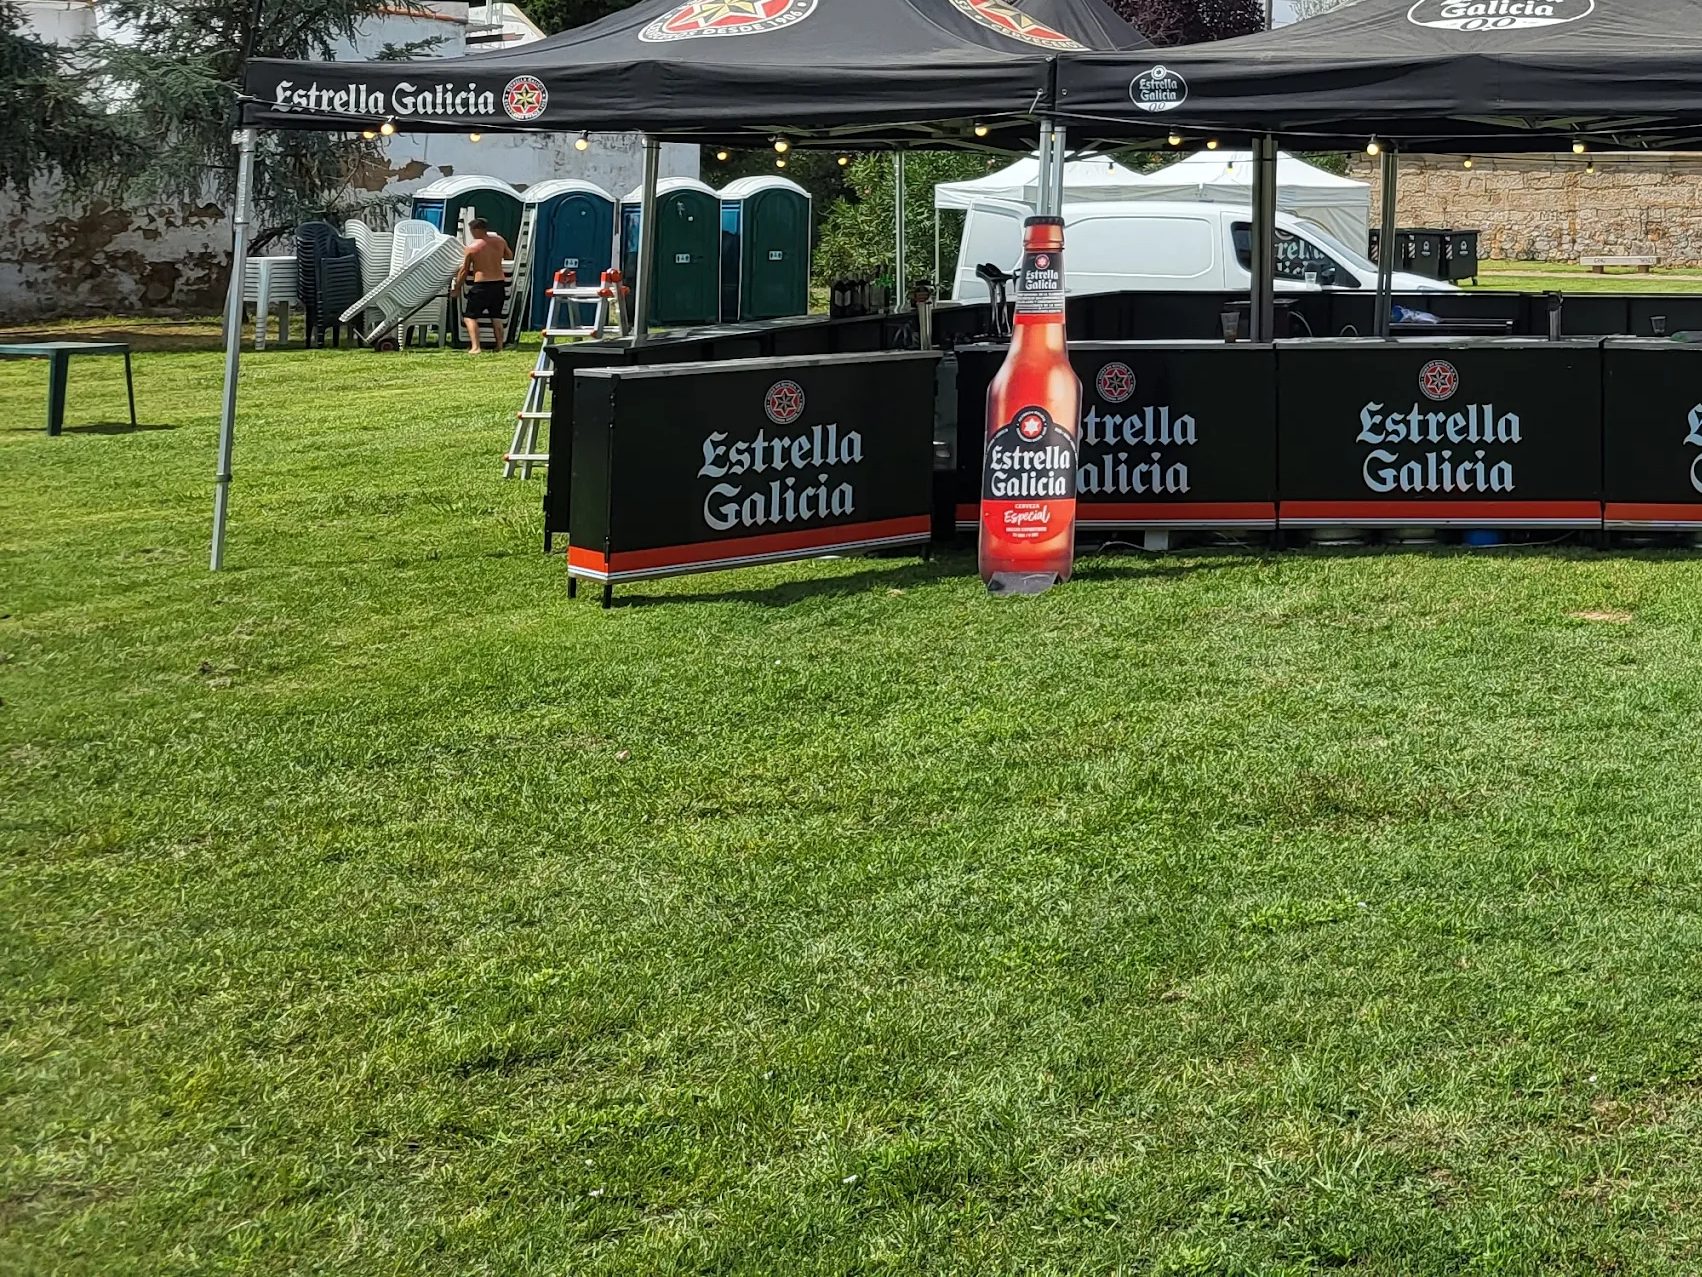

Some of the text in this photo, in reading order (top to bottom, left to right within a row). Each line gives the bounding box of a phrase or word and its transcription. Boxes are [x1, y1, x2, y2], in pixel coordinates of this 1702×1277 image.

[1440, 0, 1554, 18] Galicia
[702, 24, 764, 35] DESDE
[767, 10, 803, 27] 1906
[1139, 78, 1178, 89] Estrella
[1140, 89, 1177, 101] Galicia
[271, 80, 386, 114] Estrella
[391, 82, 495, 115] Galicia
[1025, 270, 1058, 280] Estrella
[1025, 279, 1057, 290] Galicia
[1079, 405, 1198, 446] trella
[1355, 401, 1523, 444] Estrella
[697, 423, 864, 479] Estrella
[990, 445, 1070, 471] Estrella
[991, 471, 1067, 497] Galicia
[1076, 452, 1191, 494] alicia
[1363, 449, 1516, 493] Galicia
[704, 473, 855, 530] Galicia
[1004, 505, 1050, 525] Especial
